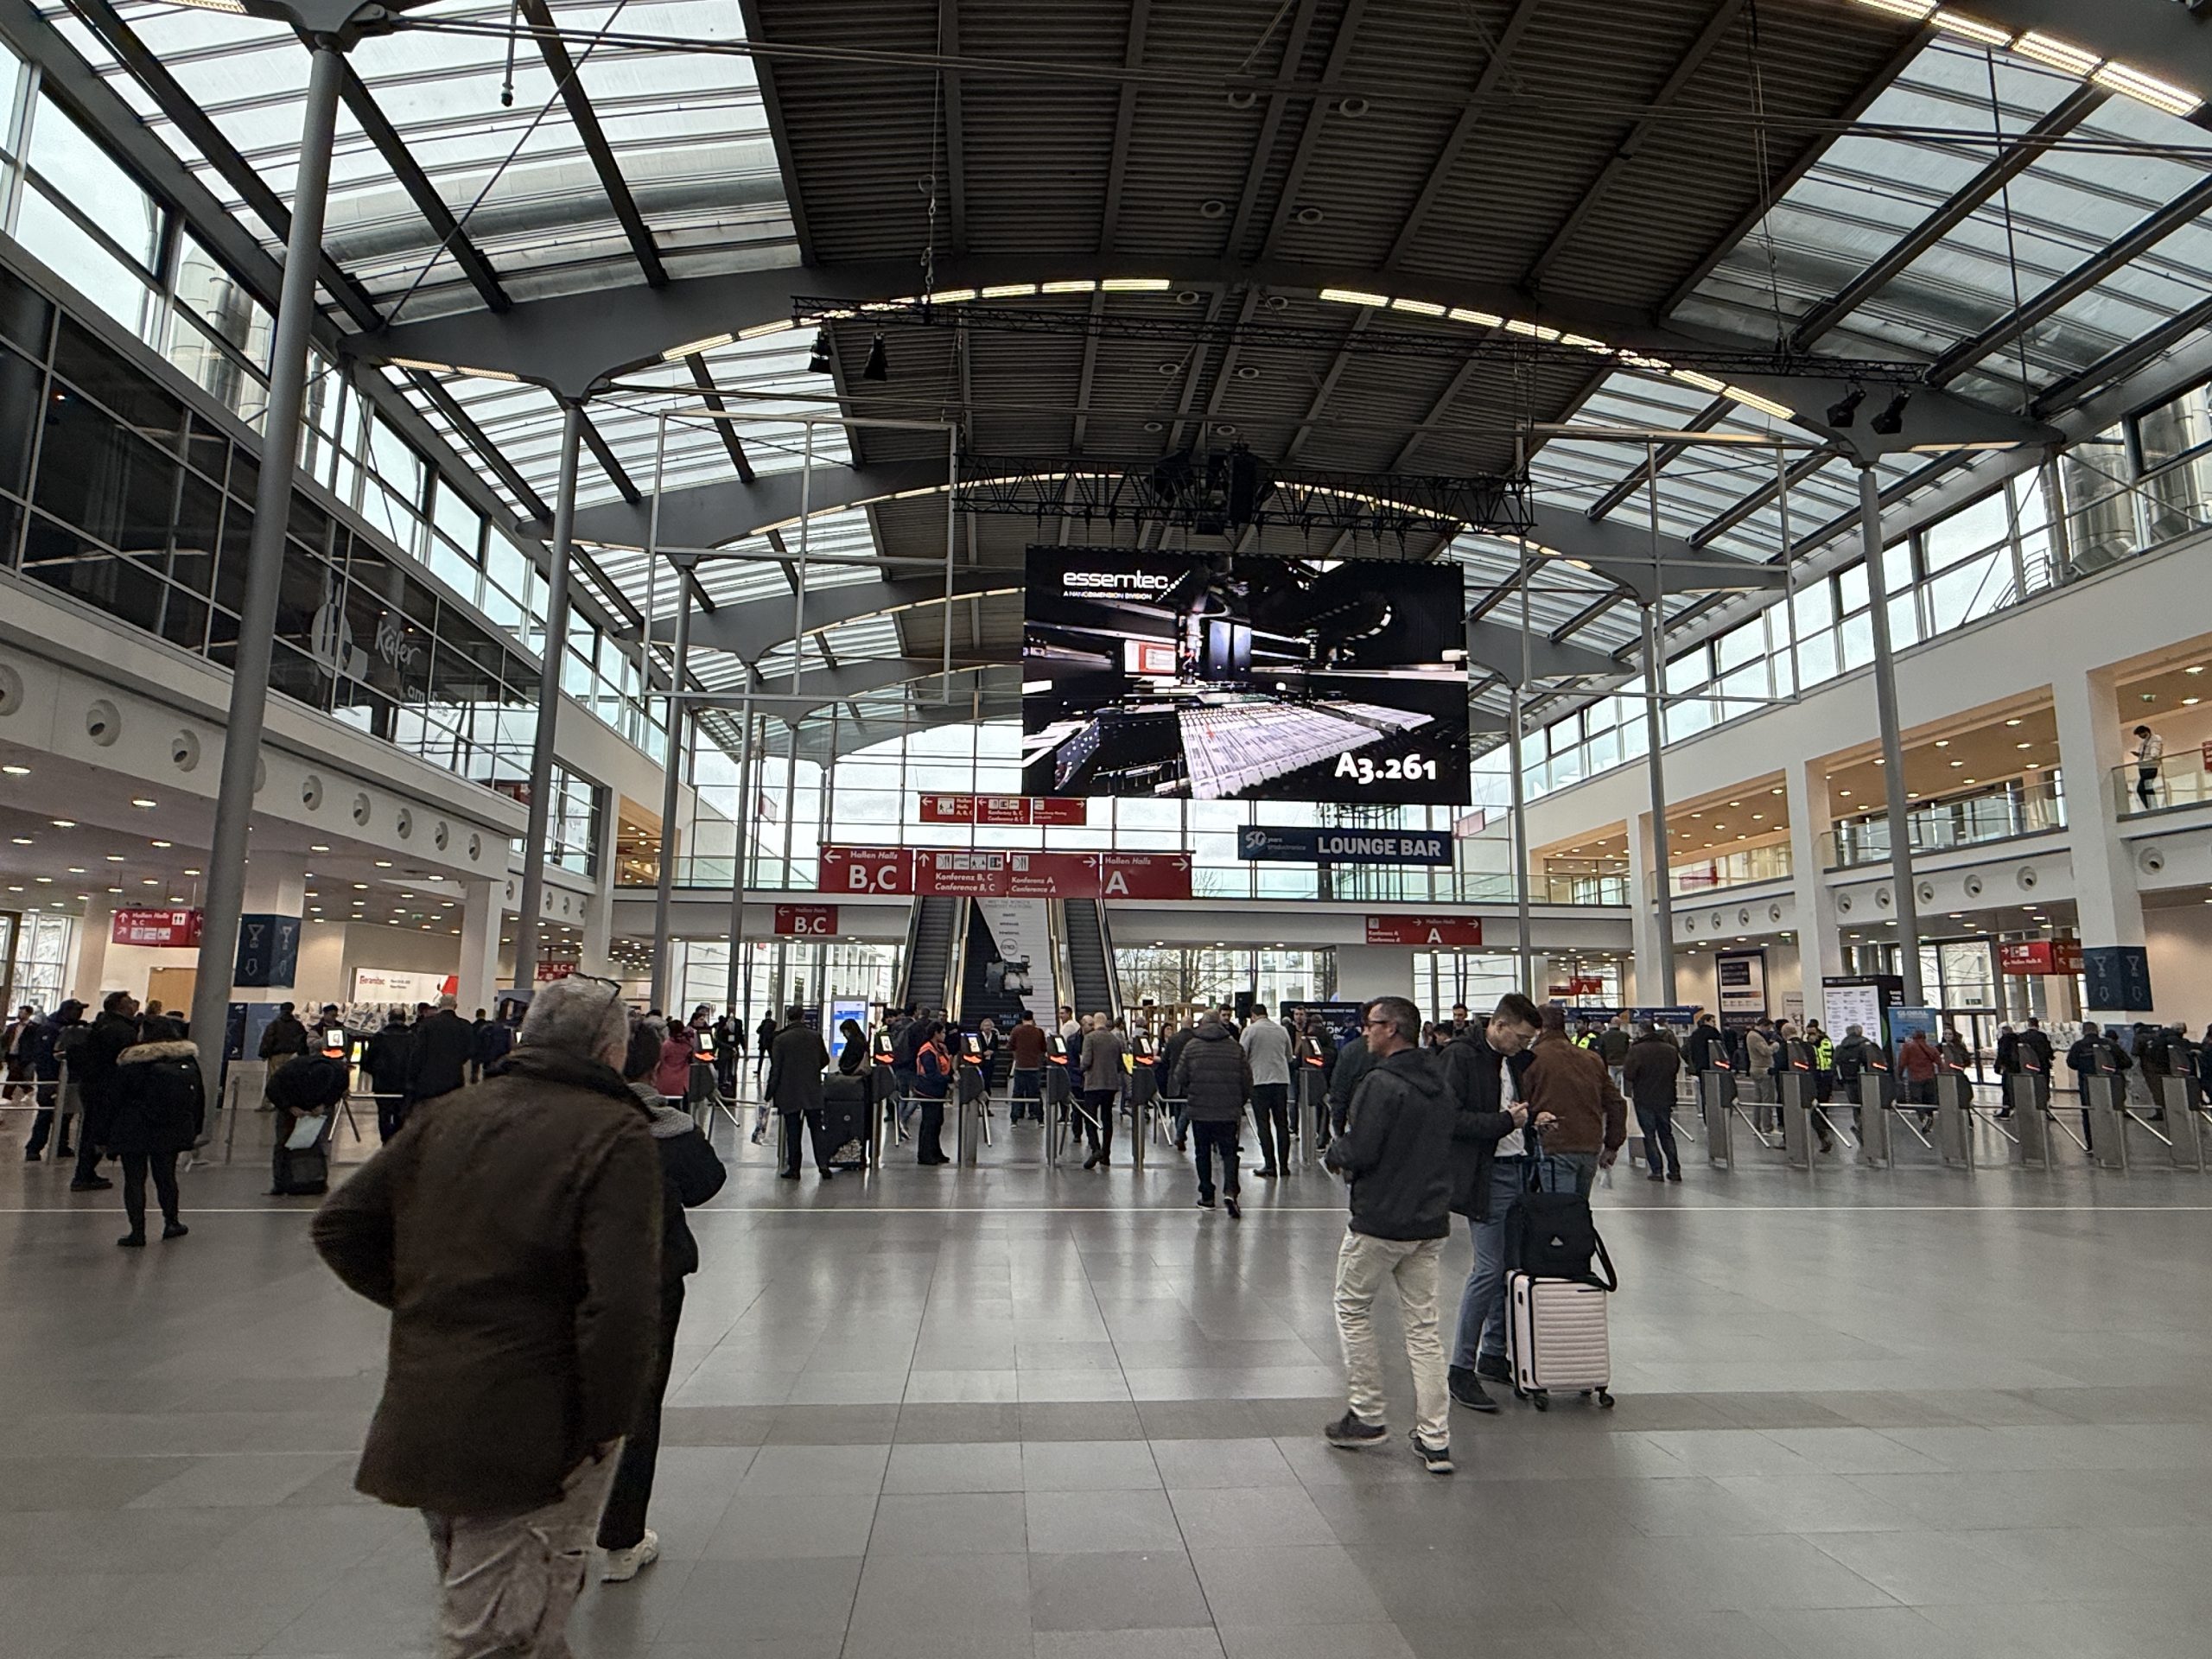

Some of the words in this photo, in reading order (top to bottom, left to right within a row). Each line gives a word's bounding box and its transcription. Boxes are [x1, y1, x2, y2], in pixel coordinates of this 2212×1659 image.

[1063, 569, 1169, 589] essemtec
[1334, 752, 1436, 785] A3.261
[1245, 830, 1267, 849] 50
[1318, 836, 1396, 855] LOUNGE
[1400, 839, 1441, 856] BAR
[850, 850, 876, 860] Hallen
[878, 851, 898, 860] Halls
[1105, 856, 1129, 865] Hallen
[935, 872, 975, 881] Konferenz
[987, 873, 993, 881] C
[1105, 870, 1128, 895] A
[935, 882, 977, 892] Conference
[988, 883, 995, 892] C
[1011, 885, 1048, 893] Conference
[1427, 927, 1442, 944] A
[1580, 984, 1590, 994] A
